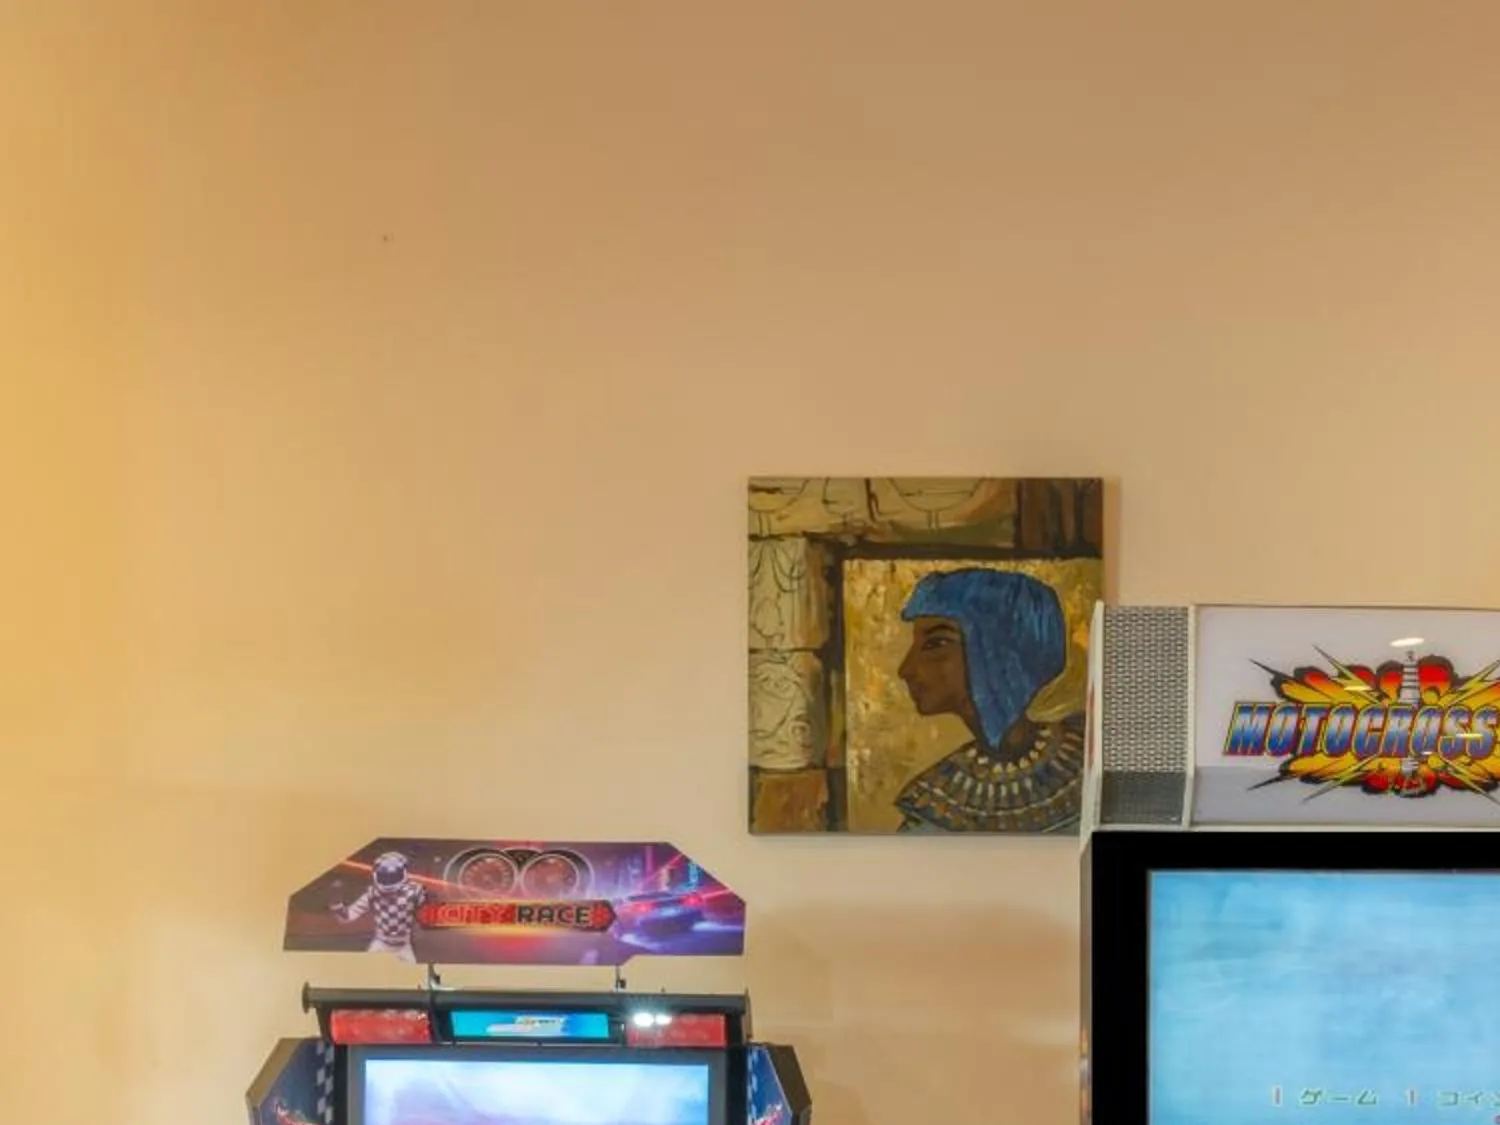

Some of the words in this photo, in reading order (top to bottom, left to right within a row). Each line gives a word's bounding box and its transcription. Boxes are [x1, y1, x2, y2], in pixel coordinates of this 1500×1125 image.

[1224, 700, 1500, 759] MOTOCROSS
[436, 903, 509, 925] CITY
[516, 903, 592, 926] RACE
